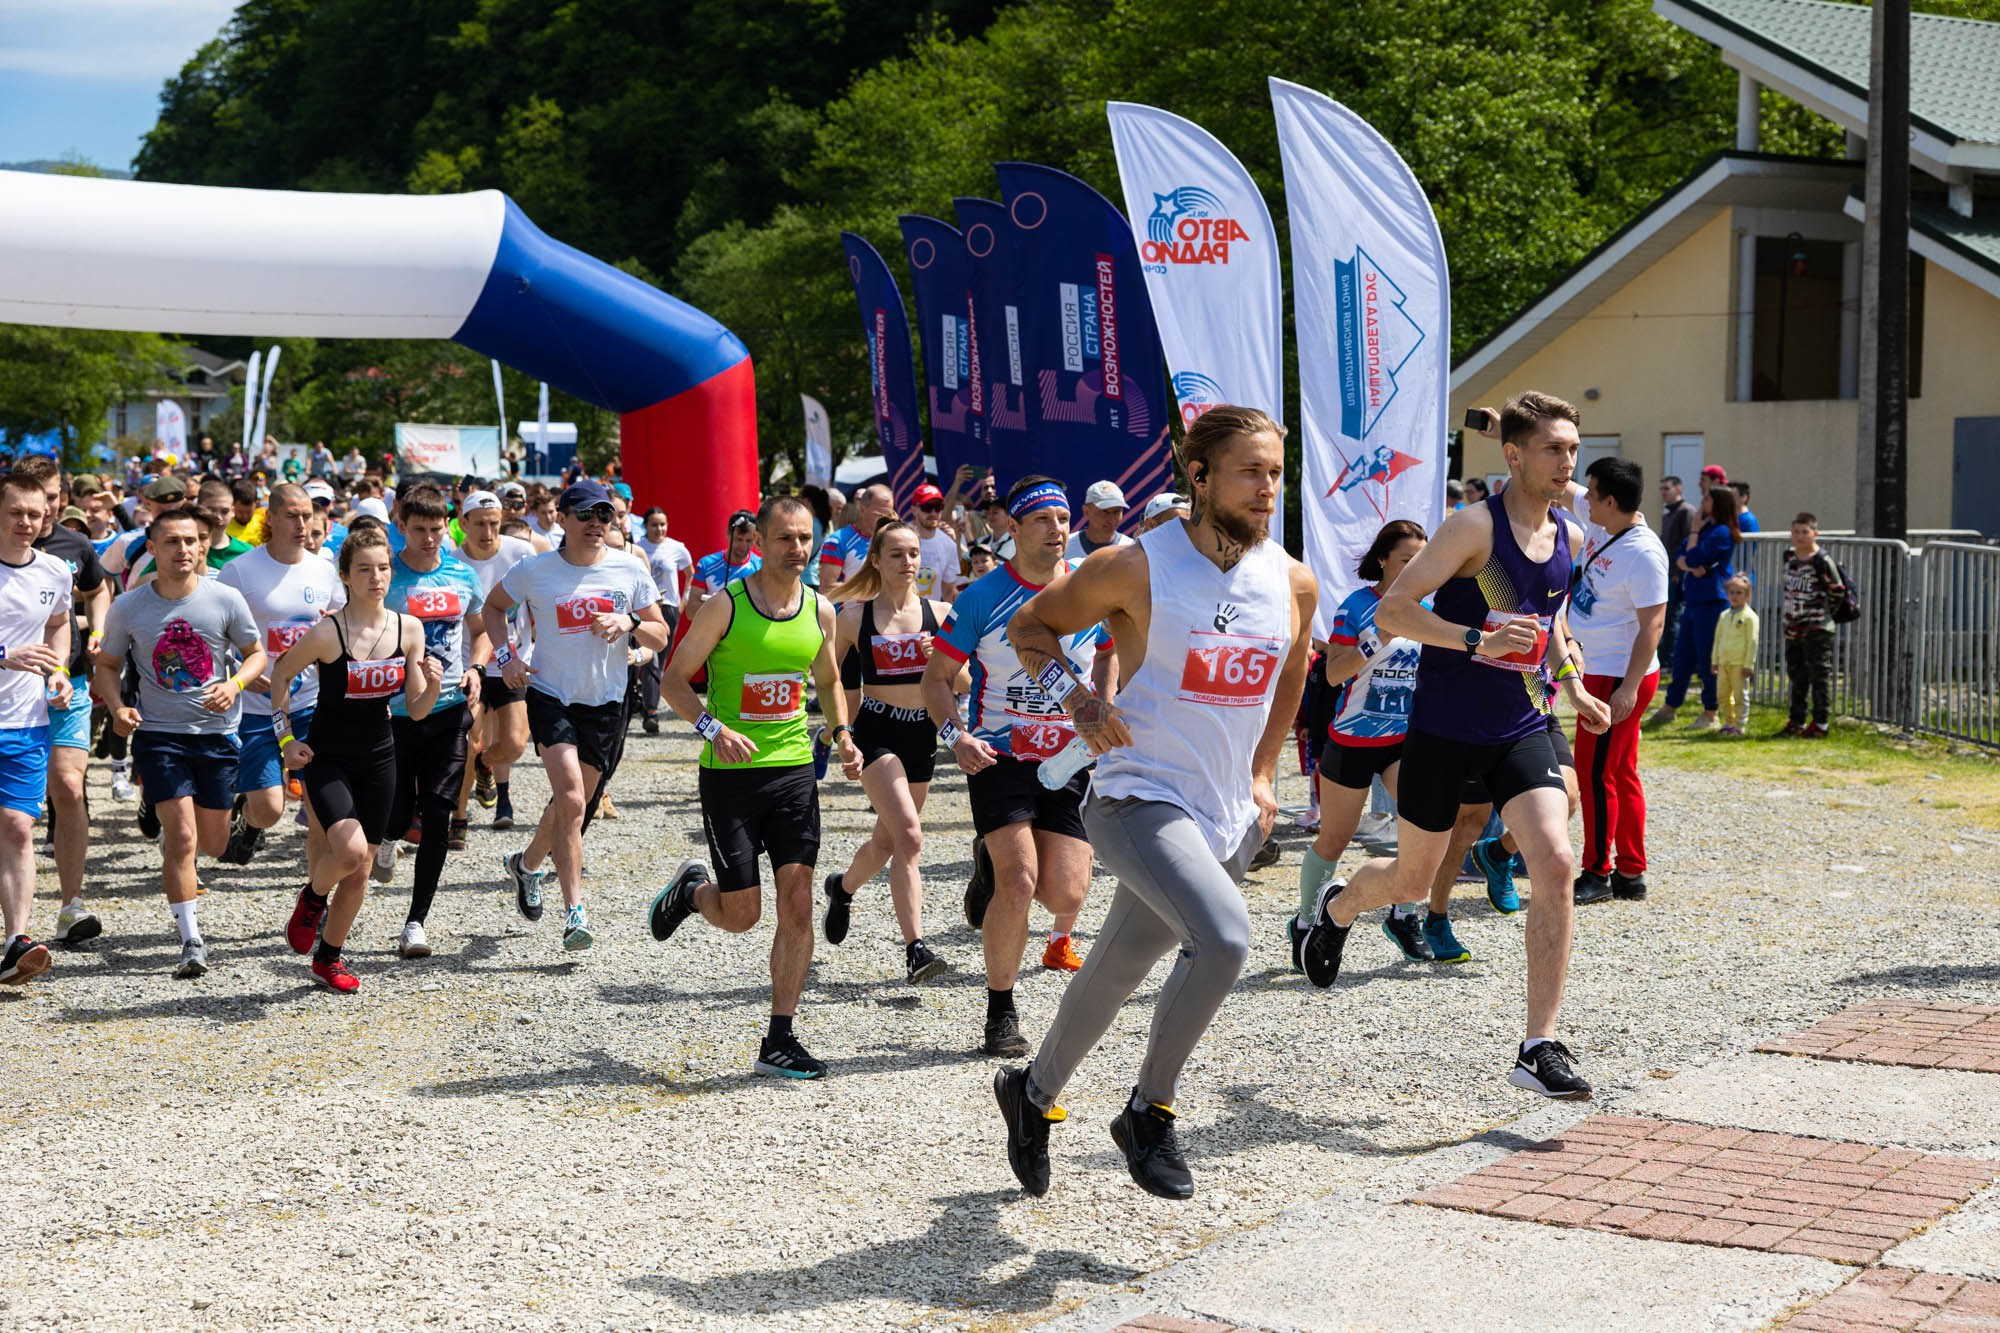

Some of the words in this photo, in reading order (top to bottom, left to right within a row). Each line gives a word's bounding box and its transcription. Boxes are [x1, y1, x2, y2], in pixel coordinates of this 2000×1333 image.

[1083, 292, 1099, 355] СТРАНА
[1097, 260, 1119, 396] ВОЗМОЖНОСТЕЙ
[1064, 303, 1081, 367] РОССИЯ
[959, 323, 969, 376] СТРАНА
[39, 591, 55, 606] 37
[423, 592, 448, 612] 33
[572, 599, 599, 620] 69
[500, 654, 509, 663] 69
[888, 642, 918, 662] 94
[360, 667, 399, 689] 109
[1042, 665, 1062, 688] 165
[1204, 649, 1268, 685] 165
[760, 683, 791, 706] 38
[890, 706, 926, 722] NIKE
[1006, 698, 1068, 714] TEA
[698, 716, 711, 730] 38
[1029, 726, 1060, 749] 43
